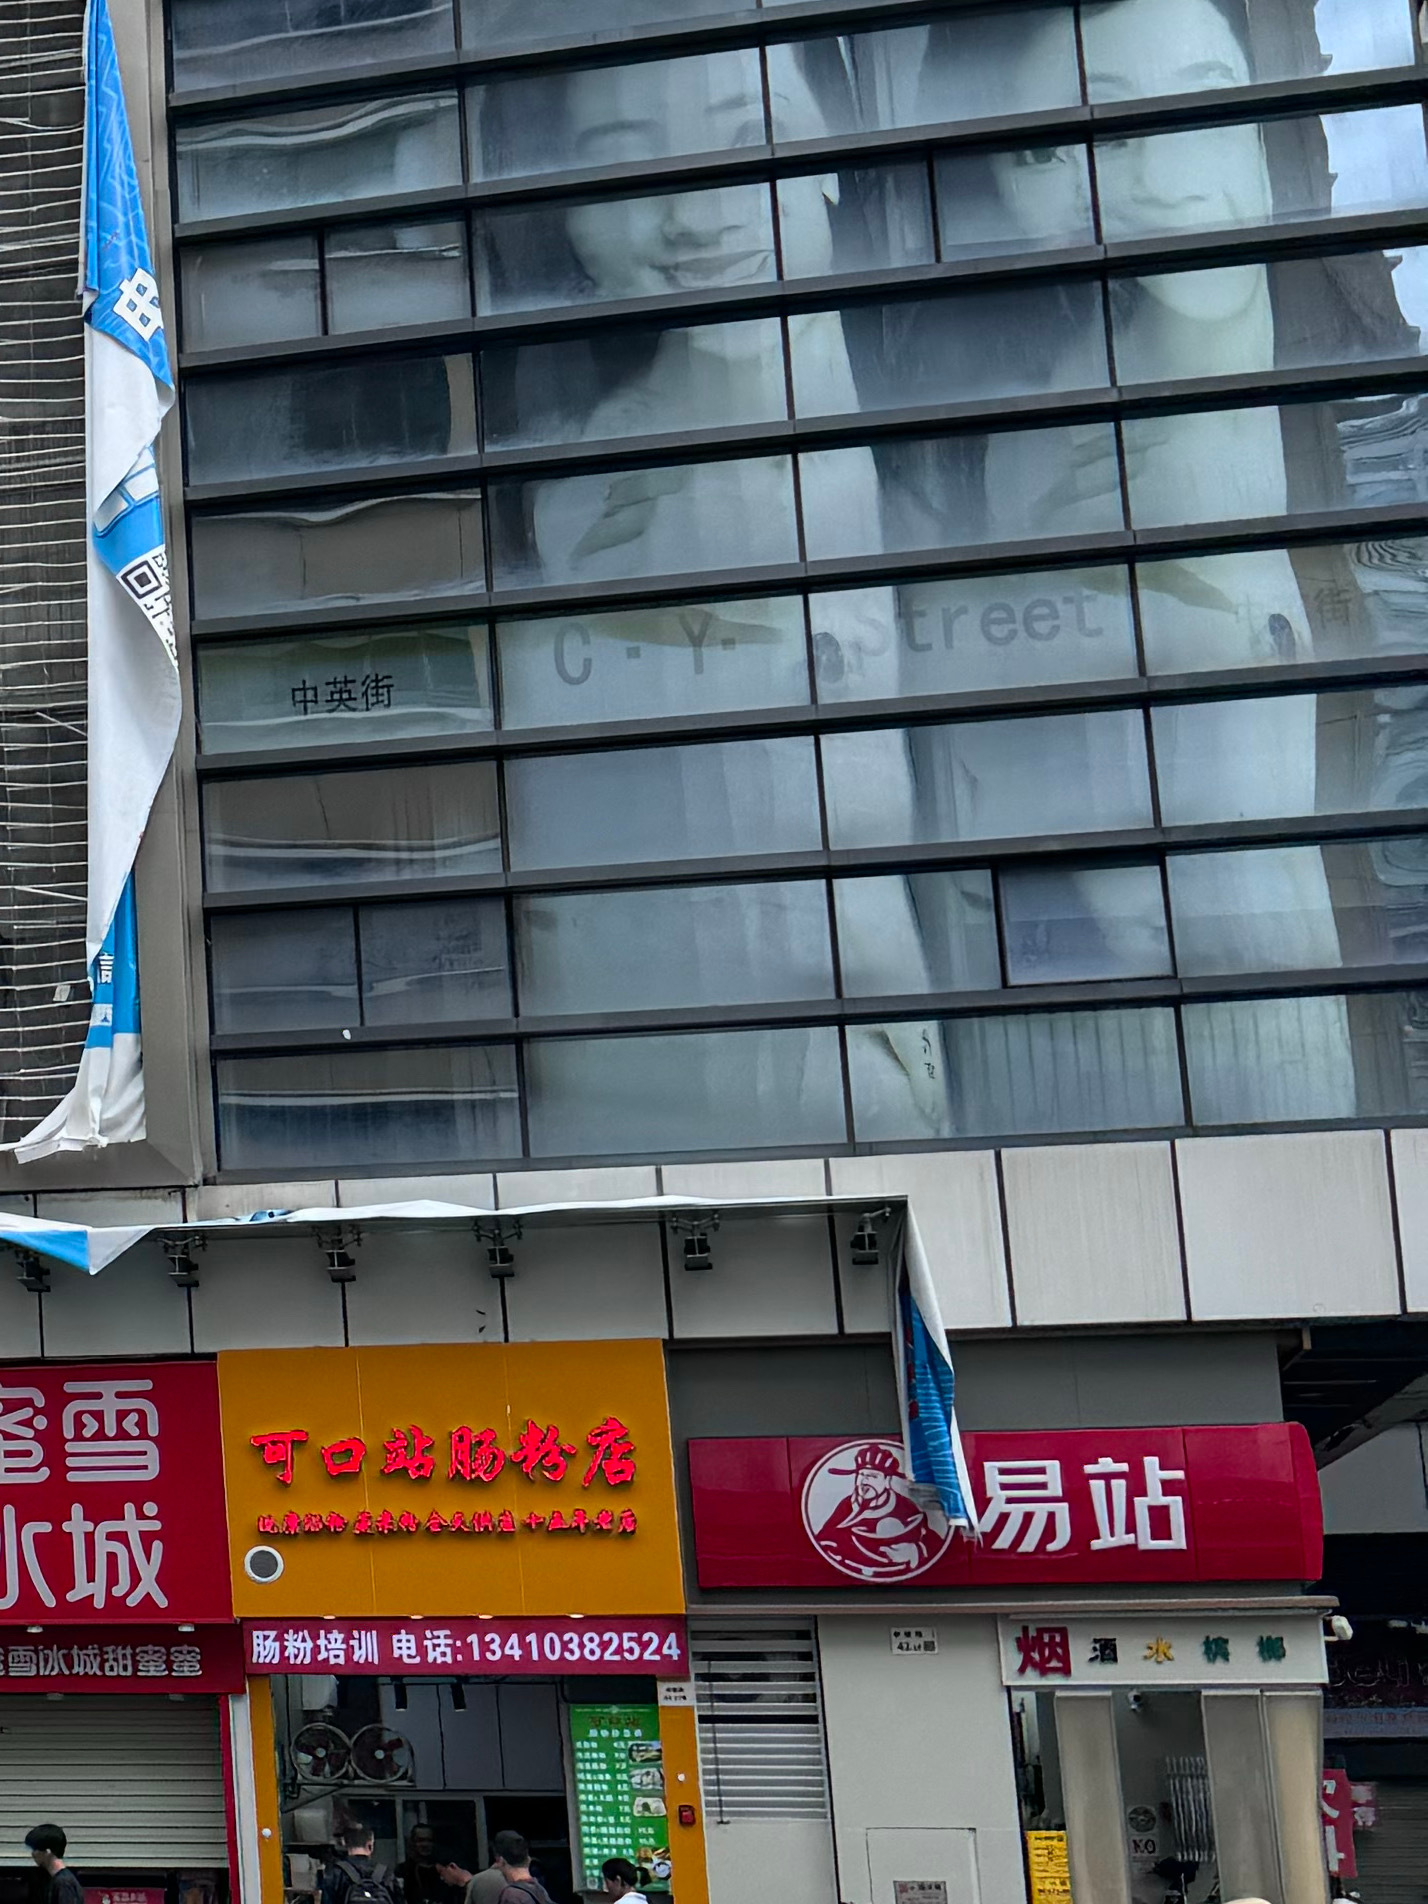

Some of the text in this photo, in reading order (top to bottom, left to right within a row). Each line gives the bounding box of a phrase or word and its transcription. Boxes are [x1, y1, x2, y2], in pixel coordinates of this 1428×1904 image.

[290, 672, 395, 716] 中英街
[249, 1415, 637, 1488] 可口站肠粉店
[979, 1455, 1187, 1553] 易站
[251, 1628, 682, 1665] 肠粉培训 电话:13410382524
